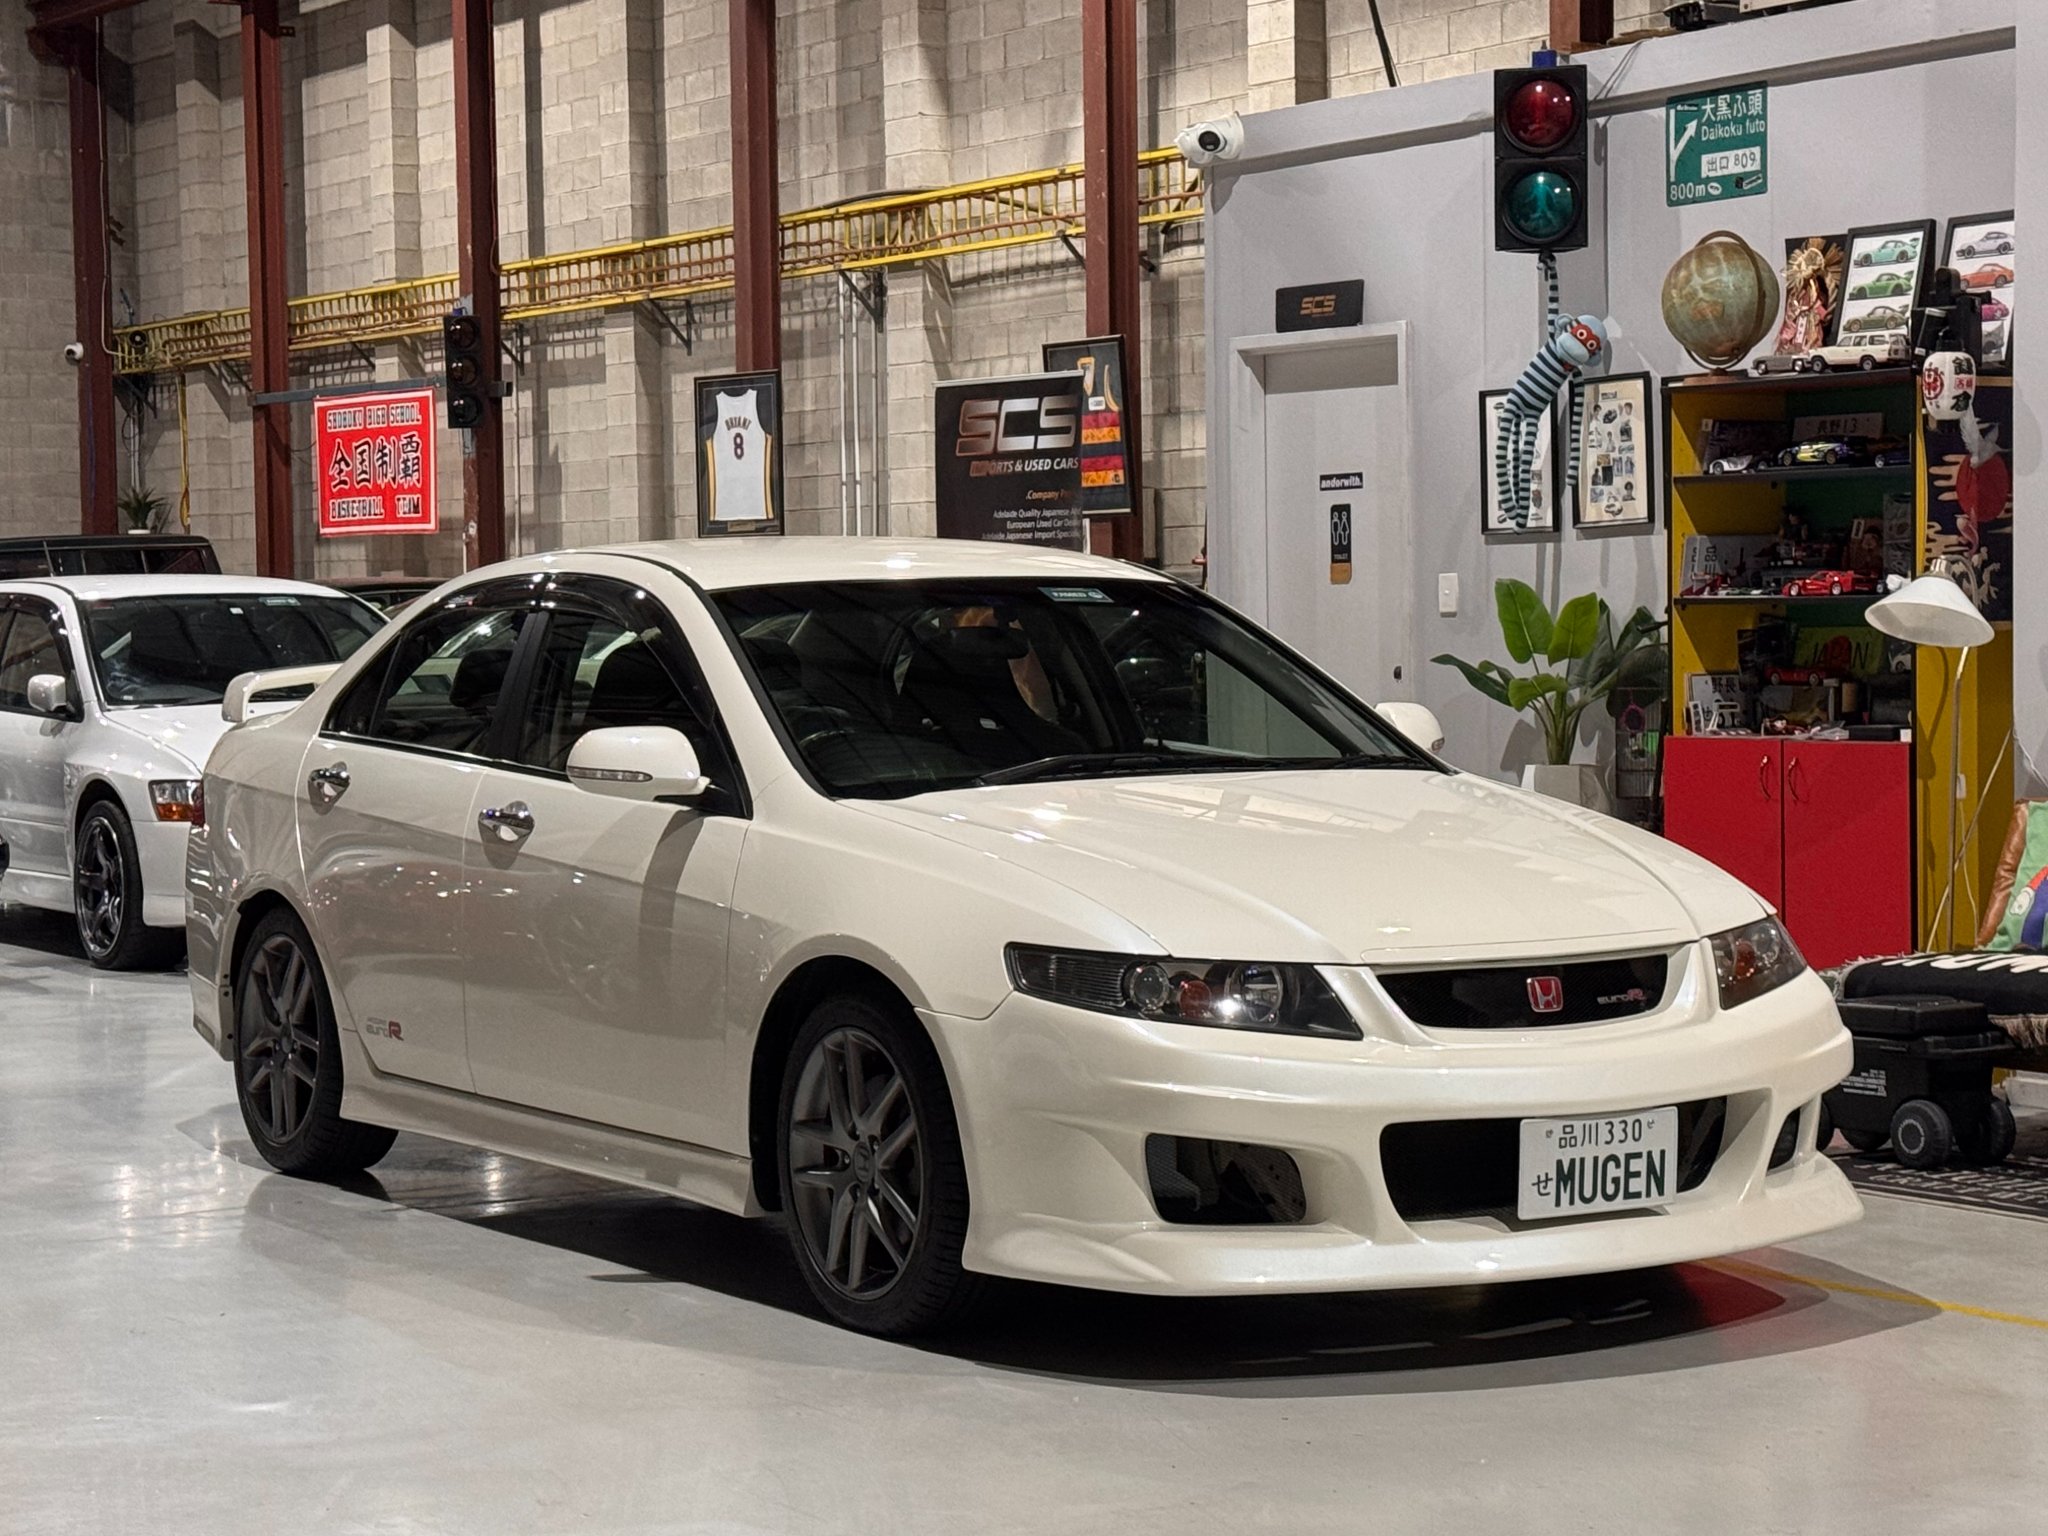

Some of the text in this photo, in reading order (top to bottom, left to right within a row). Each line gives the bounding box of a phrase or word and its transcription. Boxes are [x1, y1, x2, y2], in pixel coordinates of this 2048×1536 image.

[1701, 89, 1763, 122] 大黒ふ頭
[1701, 118, 1766, 141] Daikoku futo
[1707, 151, 1757, 173] 出口 809
[1670, 182, 1706, 201] 800m
[1300, 295, 1336, 315] SCS
[389, 402, 422, 427] SCHOOL
[956, 394, 1079, 456] SCS
[733, 432, 745, 460] 8
[328, 431, 422, 493] 全国制覇
[1015, 459, 1024, 471] &
[1025, 459, 1051, 471] USED
[1053, 457, 1079, 469] CARS
[329, 494, 421, 521] BASKETBALL TEAM
[1531, 1149, 1666, 1208] せ MUGEN
